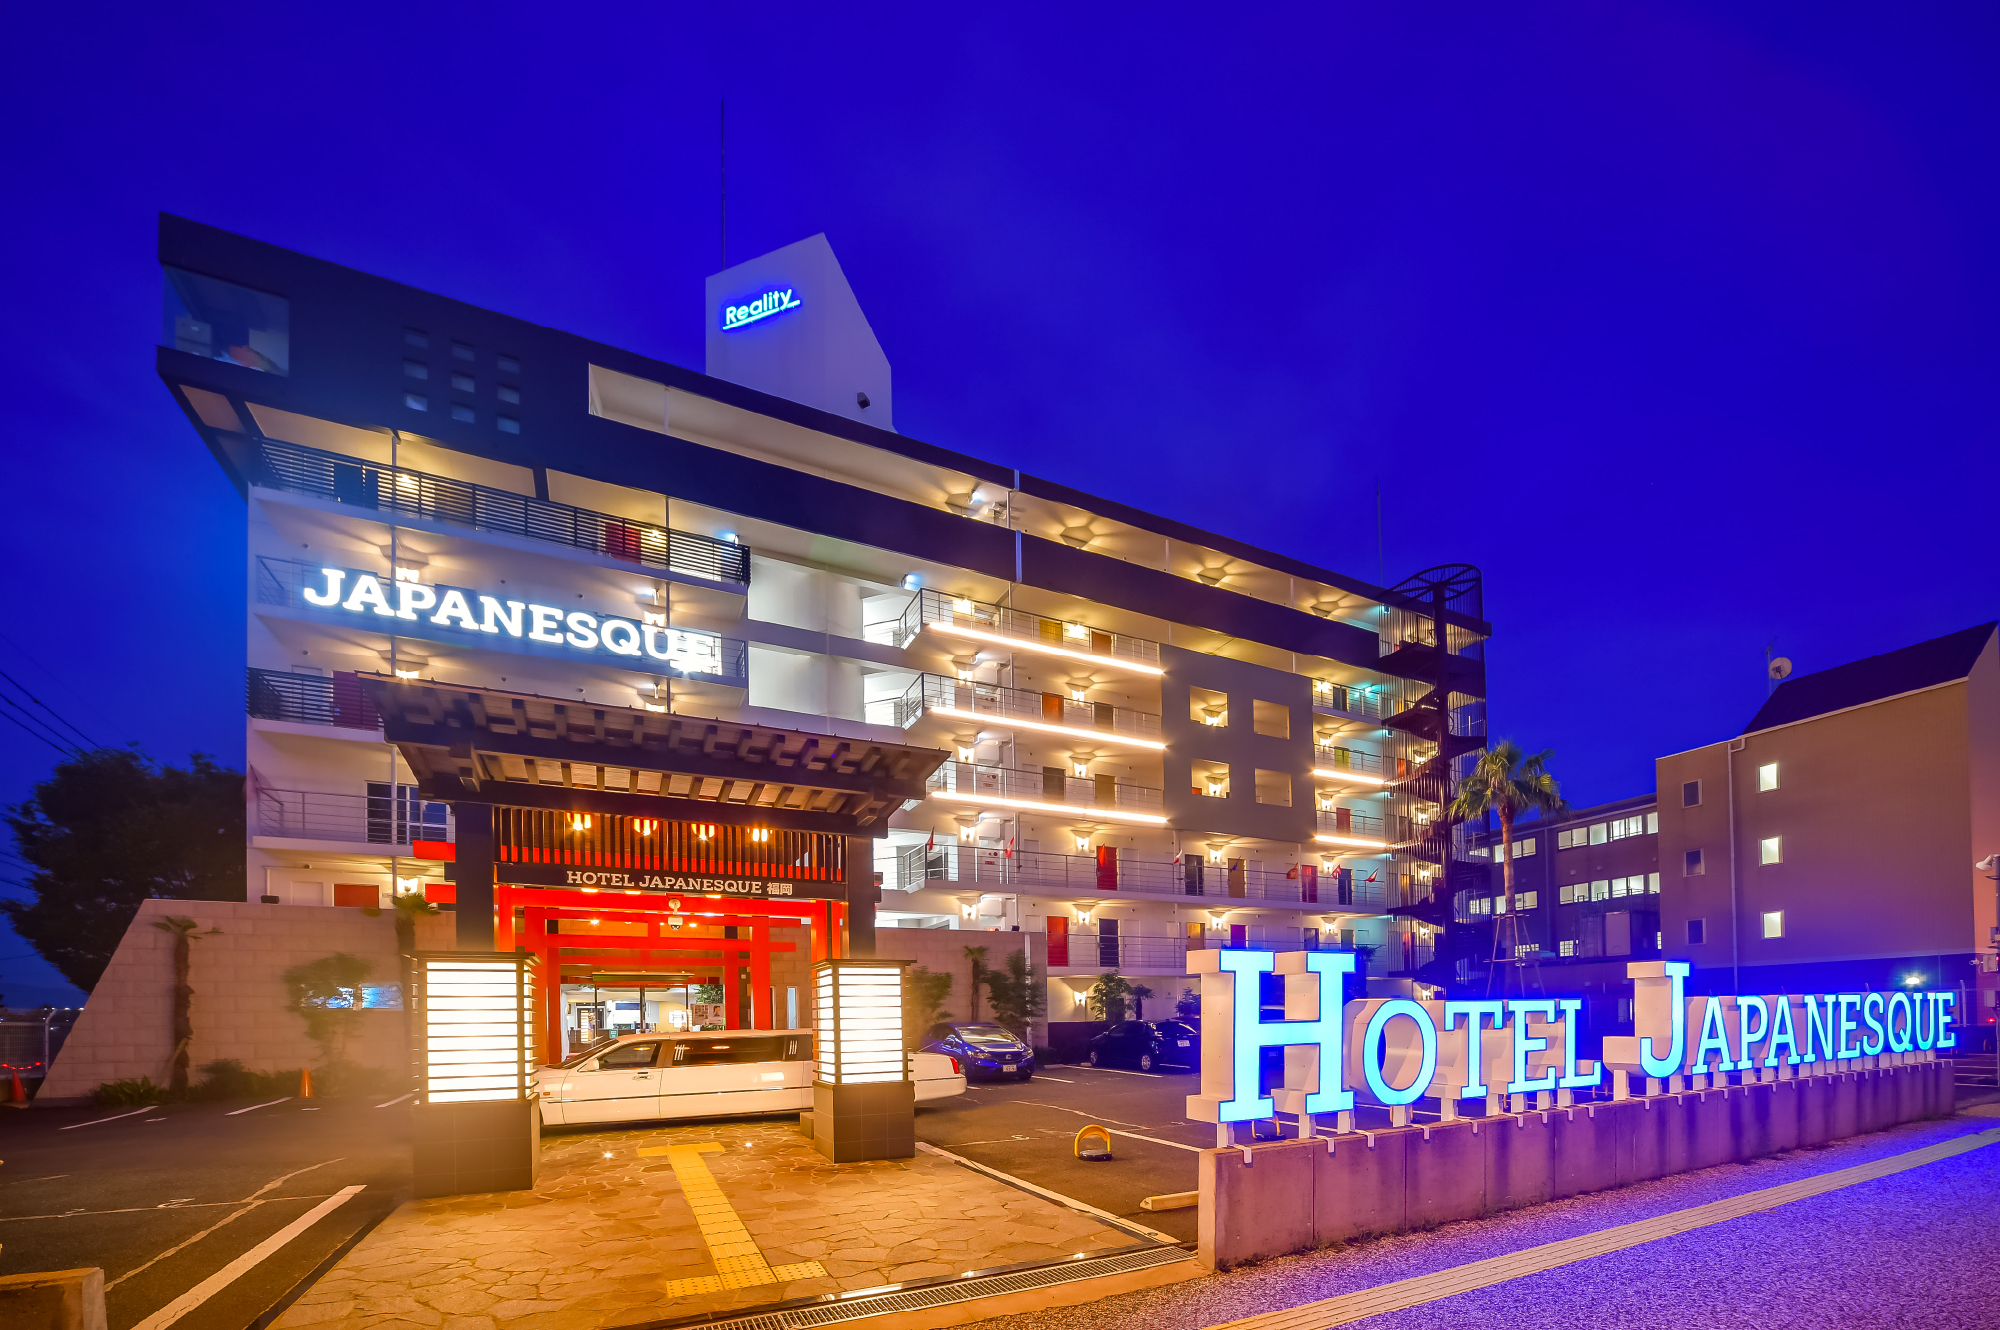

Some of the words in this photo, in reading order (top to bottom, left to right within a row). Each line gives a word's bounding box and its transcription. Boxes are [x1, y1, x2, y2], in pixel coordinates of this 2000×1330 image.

[725, 288, 793, 326] Reality
[566, 870, 635, 887] HOTEL
[639, 875, 762, 894] JAPANESQUE
[766, 882, 793, 896] 福岡
[1218, 949, 1602, 1124] HOTEL
[1640, 961, 1957, 1078] JAPANESQUE
